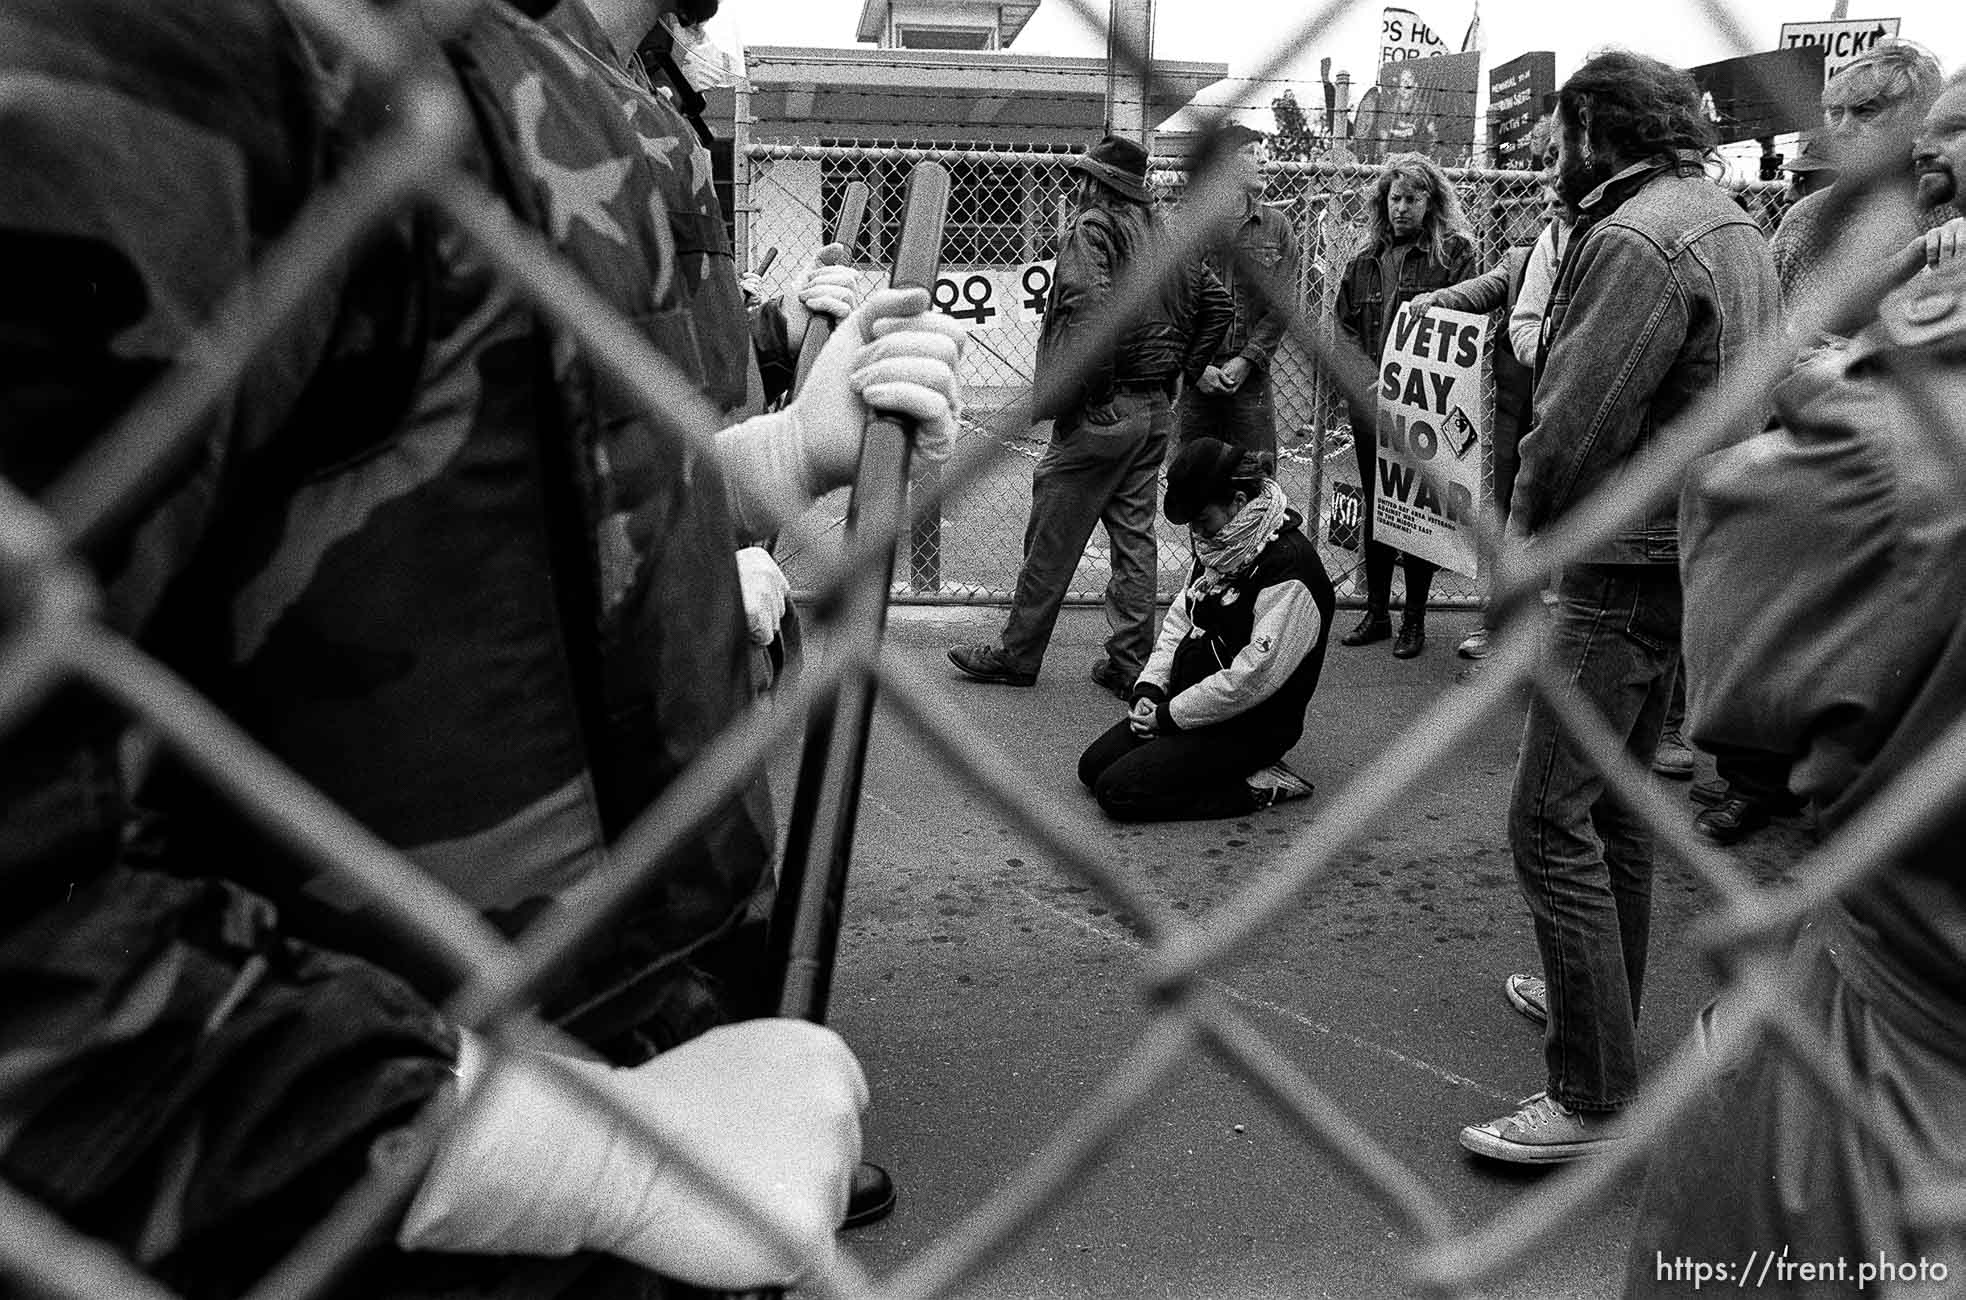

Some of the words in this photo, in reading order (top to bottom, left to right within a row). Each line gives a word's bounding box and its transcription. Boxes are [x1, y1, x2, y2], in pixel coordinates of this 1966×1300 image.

[1394, 311, 1480, 368] VETS
[1382, 362, 1456, 415] SAY
[1378, 409, 1438, 461] NO
[1377, 503, 1402, 517] AGAINST
[1403, 513, 1415, 522] WAR
[1377, 497, 1398, 509] UNITED
[1398, 504, 1410, 513] BAY
[1411, 510, 1426, 520] AREA
[1428, 517, 1457, 531] VETERANS
[1378, 457, 1472, 526] WAR
[1385, 512, 1395, 521] THE
[1396, 517, 1417, 530] MIDDLE
[1418, 525, 1432, 536] EAST
